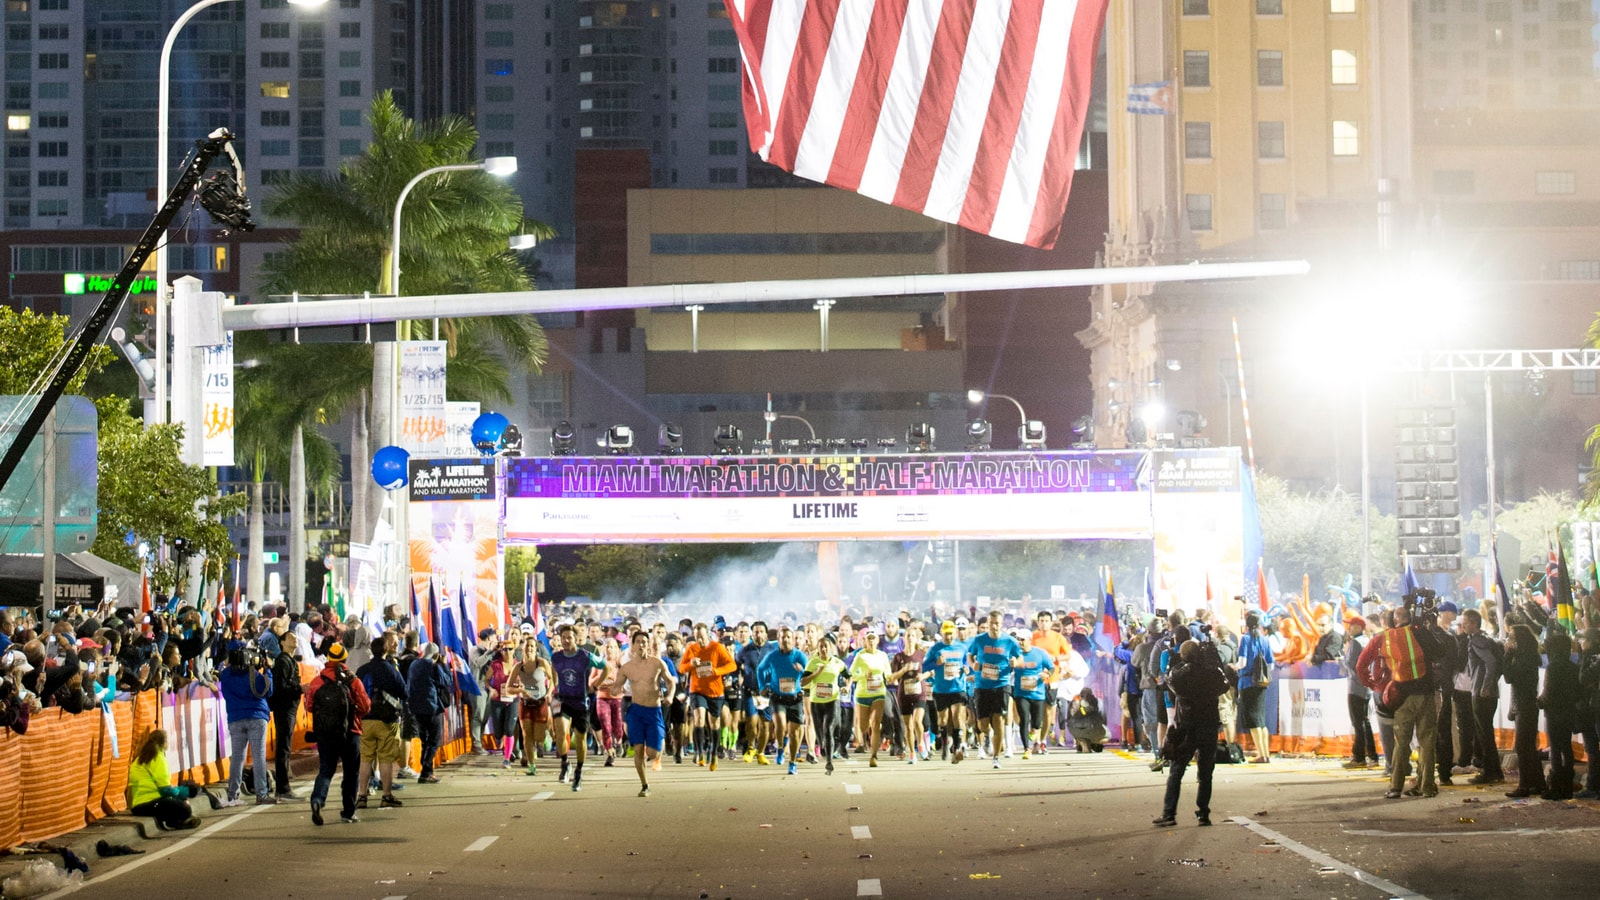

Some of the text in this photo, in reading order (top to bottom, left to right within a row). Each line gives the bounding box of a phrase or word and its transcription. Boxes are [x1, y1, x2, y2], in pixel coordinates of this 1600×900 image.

[88, 275, 158, 294] Holy In
[403, 394, 444, 405] 1/25/15
[446, 465, 485, 477] LIFETIME
[562, 458, 1091, 493] MIAMI MARATHON & HALF MARATHON
[413, 478, 488, 488] MIAMI MARATHON
[413, 488, 429, 496] AND
[543, 511, 591, 520] Panasonic
[793, 503, 858, 519] LIFETIME
[39, 583, 92, 597] LETIME
